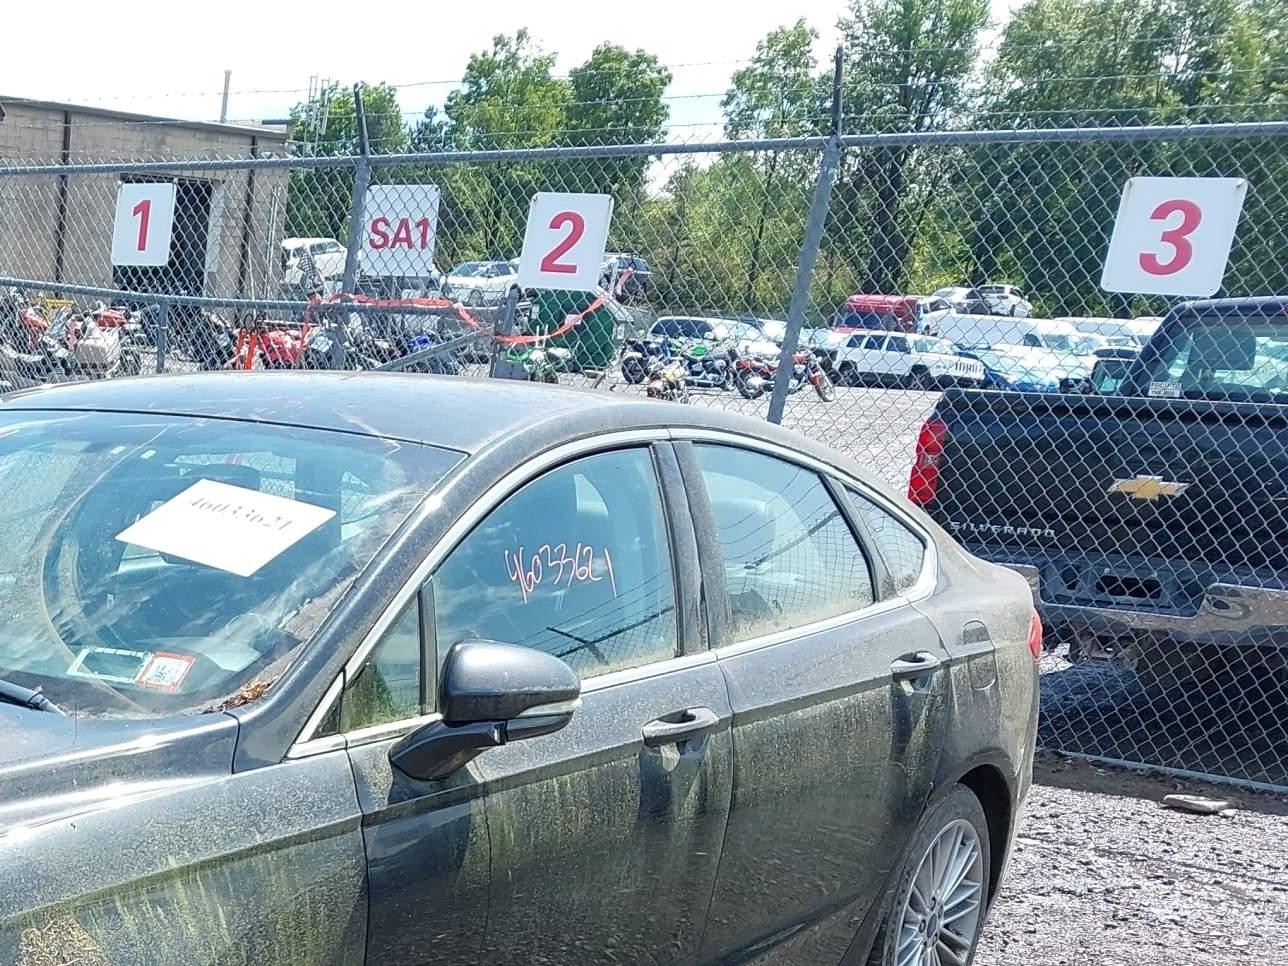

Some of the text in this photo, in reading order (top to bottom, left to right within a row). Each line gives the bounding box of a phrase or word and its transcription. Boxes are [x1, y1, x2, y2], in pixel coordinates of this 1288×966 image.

[132, 199, 152, 251] 1
[369, 217, 430, 250] SA1
[539, 211, 585, 274] 2
[1138, 199, 1203, 276] 3
[949, 520, 1056, 538] SILVERADO
[504, 543, 618, 604] 46033621
